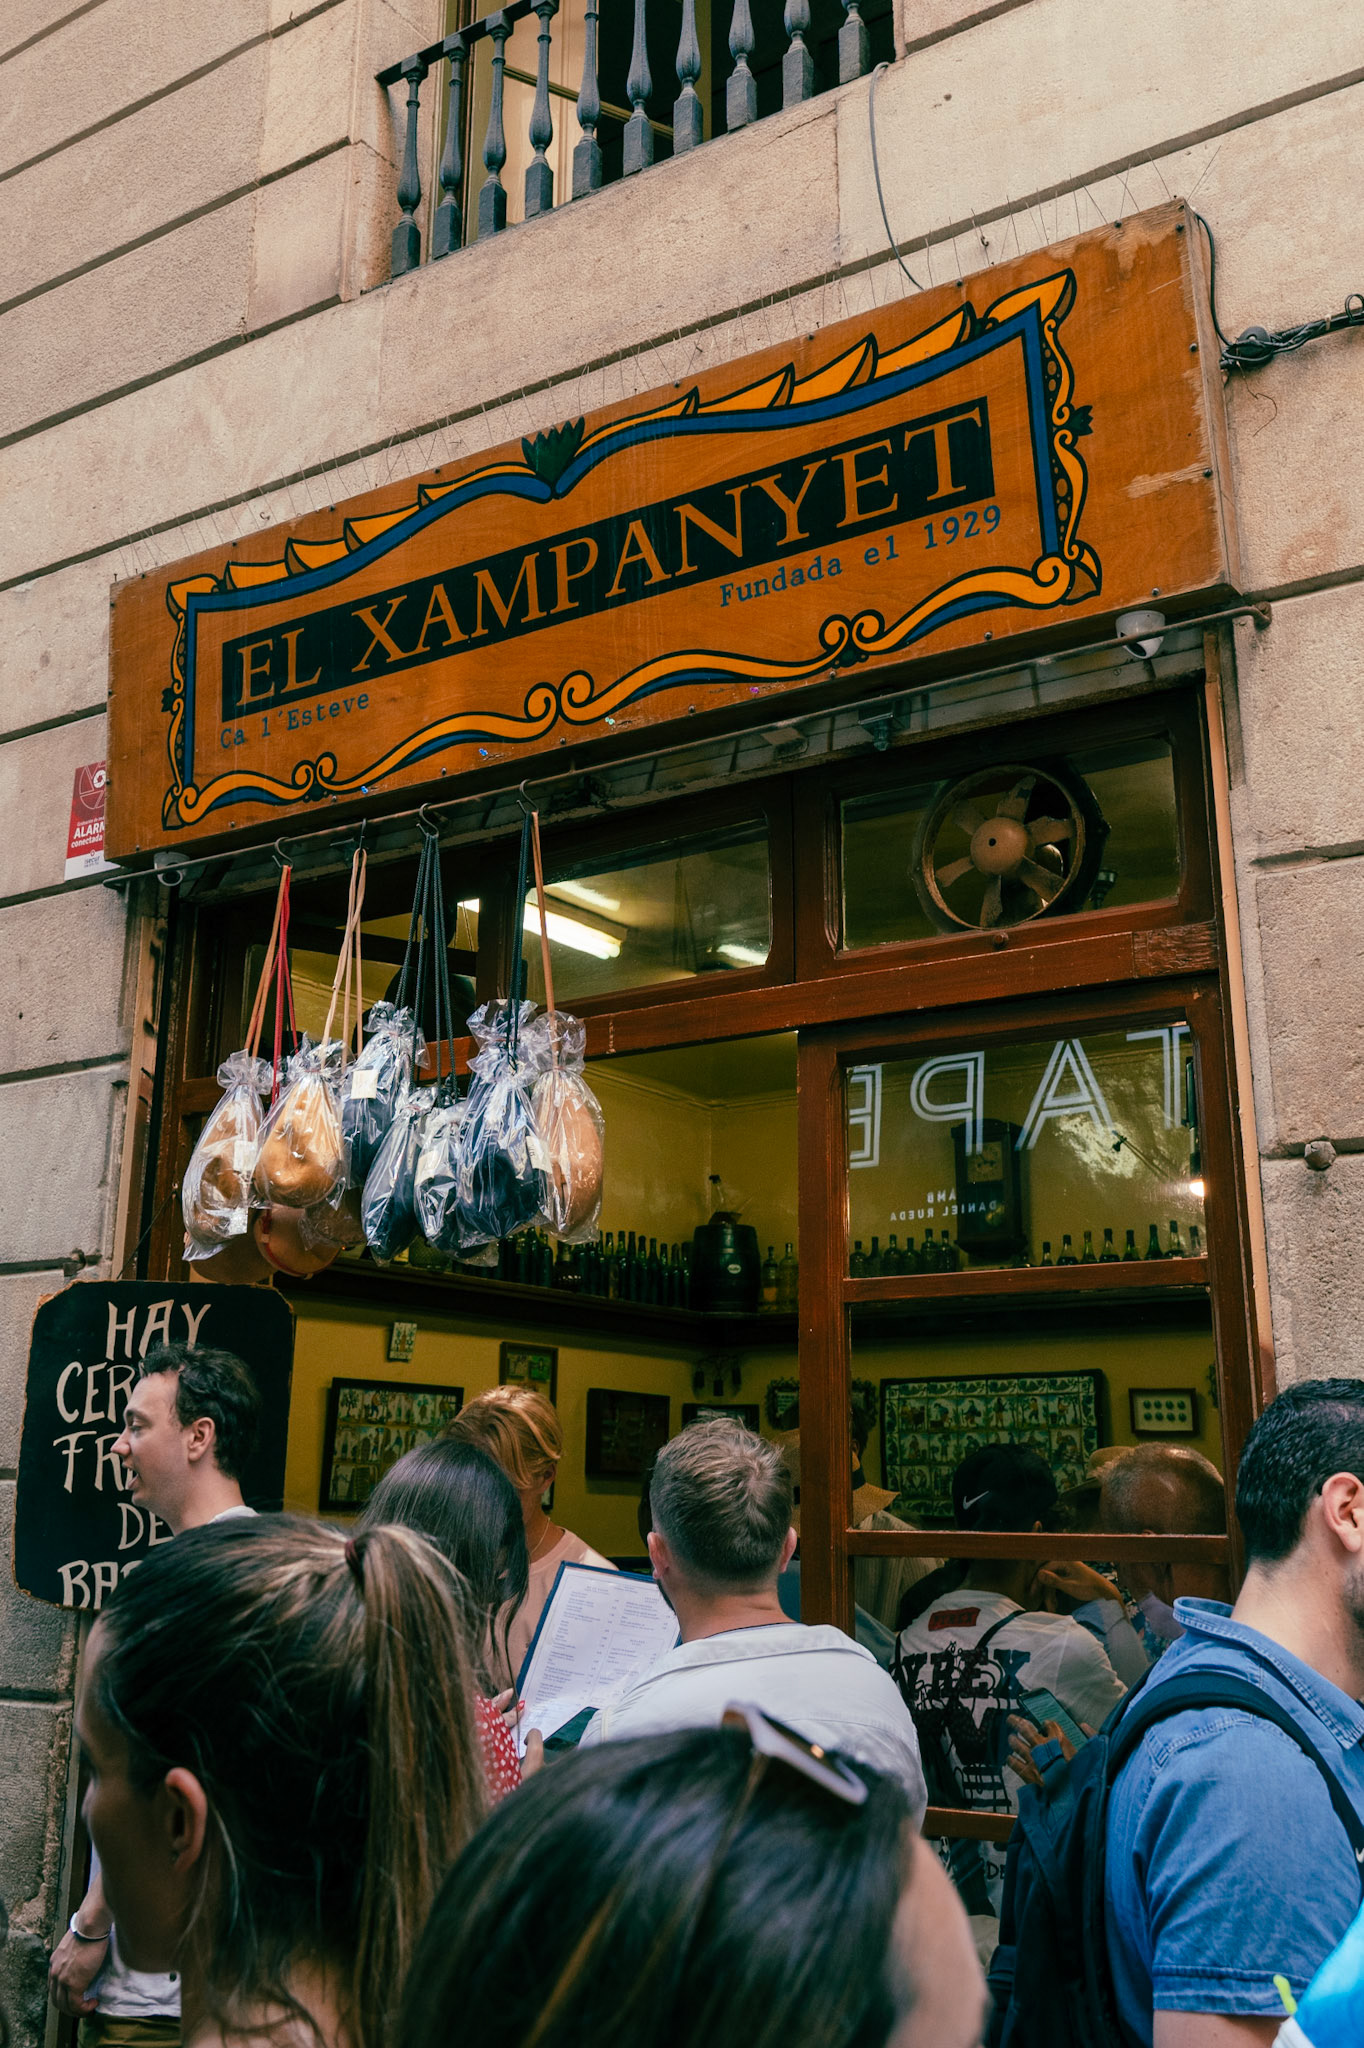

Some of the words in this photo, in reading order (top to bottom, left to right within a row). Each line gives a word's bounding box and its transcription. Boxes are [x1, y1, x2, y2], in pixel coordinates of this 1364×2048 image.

[234, 627, 322, 708] EL
[352, 405, 983, 671] XAMPANYET
[719, 555, 843, 607] Fundada
[863, 535, 899, 566] el
[924, 504, 1001, 550] 1929
[220, 727, 247, 749] Ca
[105, 1299, 211, 1361] HAY
[56, 1361, 145, 1424] CER
